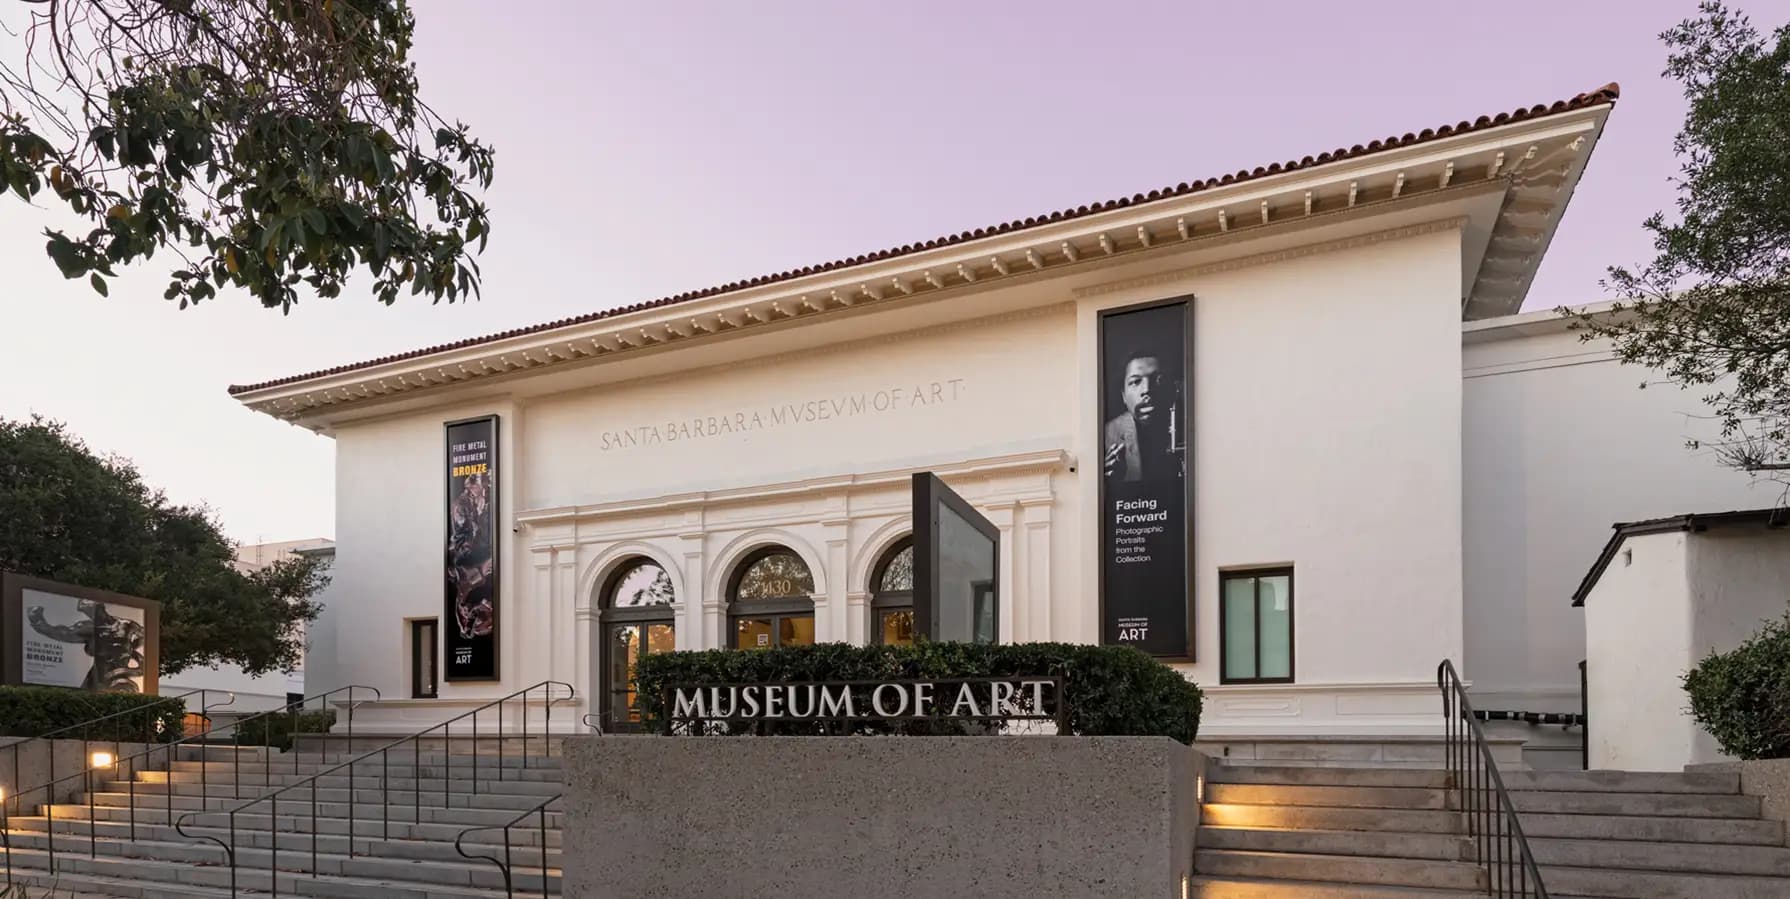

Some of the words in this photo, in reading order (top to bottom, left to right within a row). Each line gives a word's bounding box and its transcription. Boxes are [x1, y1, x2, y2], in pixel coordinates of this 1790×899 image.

[600, 425, 663, 451] SANTA
[667, 412, 763, 442] BARBARA
[873, 388, 903, 412] OF
[911, 379, 963, 407] ART
[453, 443, 466, 452] FIRE
[468, 441, 487, 450] METAL
[453, 452, 487, 464] MONUMENT
[453, 463, 487, 477] BRONZE
[1116, 498, 1157, 511] Facing
[1116, 510, 1167, 524] Forward
[1115, 525, 1164, 536] Photographic
[1115, 536, 1146, 545] Portraits
[1115, 555, 1152, 564] Collection
[1118, 628, 1148, 641] ART
[26, 653, 63, 663] BRONZE
[456, 655, 472, 664] ART
[671, 683, 857, 718] MUSEUM
[871, 682, 935, 717] OF
[950, 680, 1055, 717] ART
